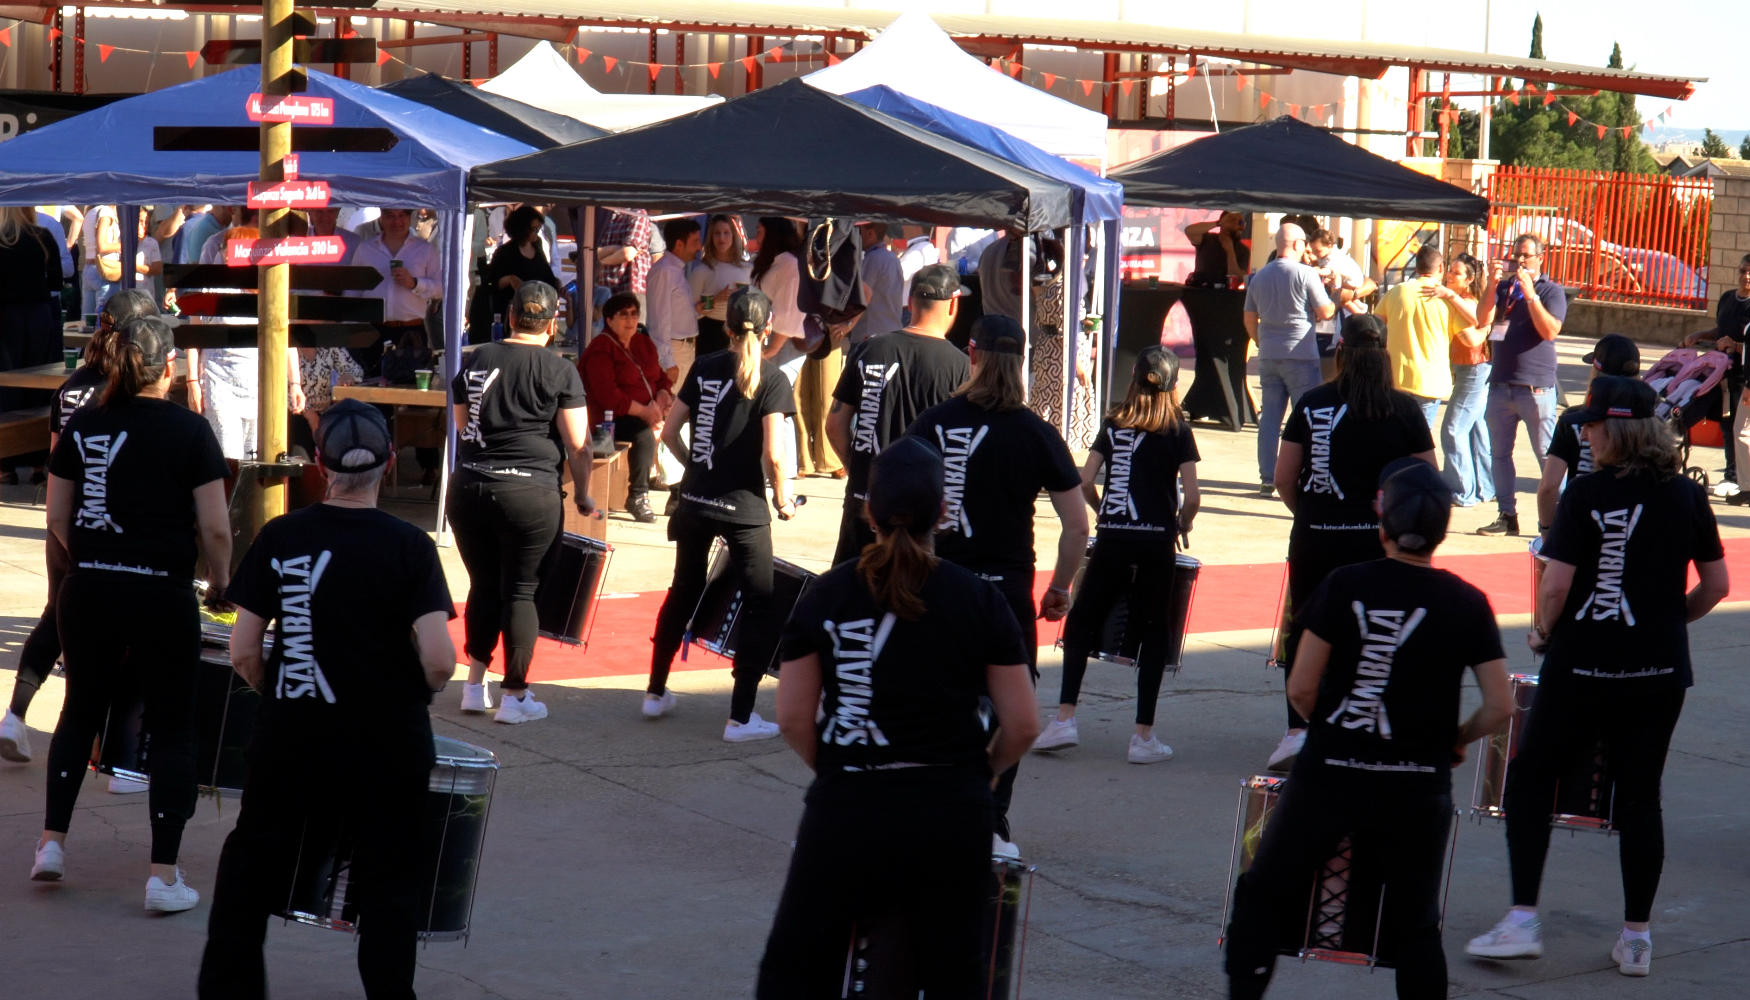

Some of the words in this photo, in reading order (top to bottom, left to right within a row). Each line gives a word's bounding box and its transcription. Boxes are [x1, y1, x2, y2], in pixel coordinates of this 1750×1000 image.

[321, 103, 329, 117] km
[317, 186, 326, 200] km
[274, 241, 309, 257] Valencia
[311, 241, 326, 256] 310
[327, 240, 338, 254] km
[692, 380, 722, 463] SAMBALA
[855, 364, 886, 454] SAMBALA
[1311, 406, 1334, 495] SAMBALA
[938, 427, 973, 532] SAMBALA
[1106, 428, 1136, 516] SAMBALA
[1592, 508, 1628, 621] SAMBALA
[282, 555, 316, 698] SAMBALA
[1341, 610, 1405, 733] SAMBALA
